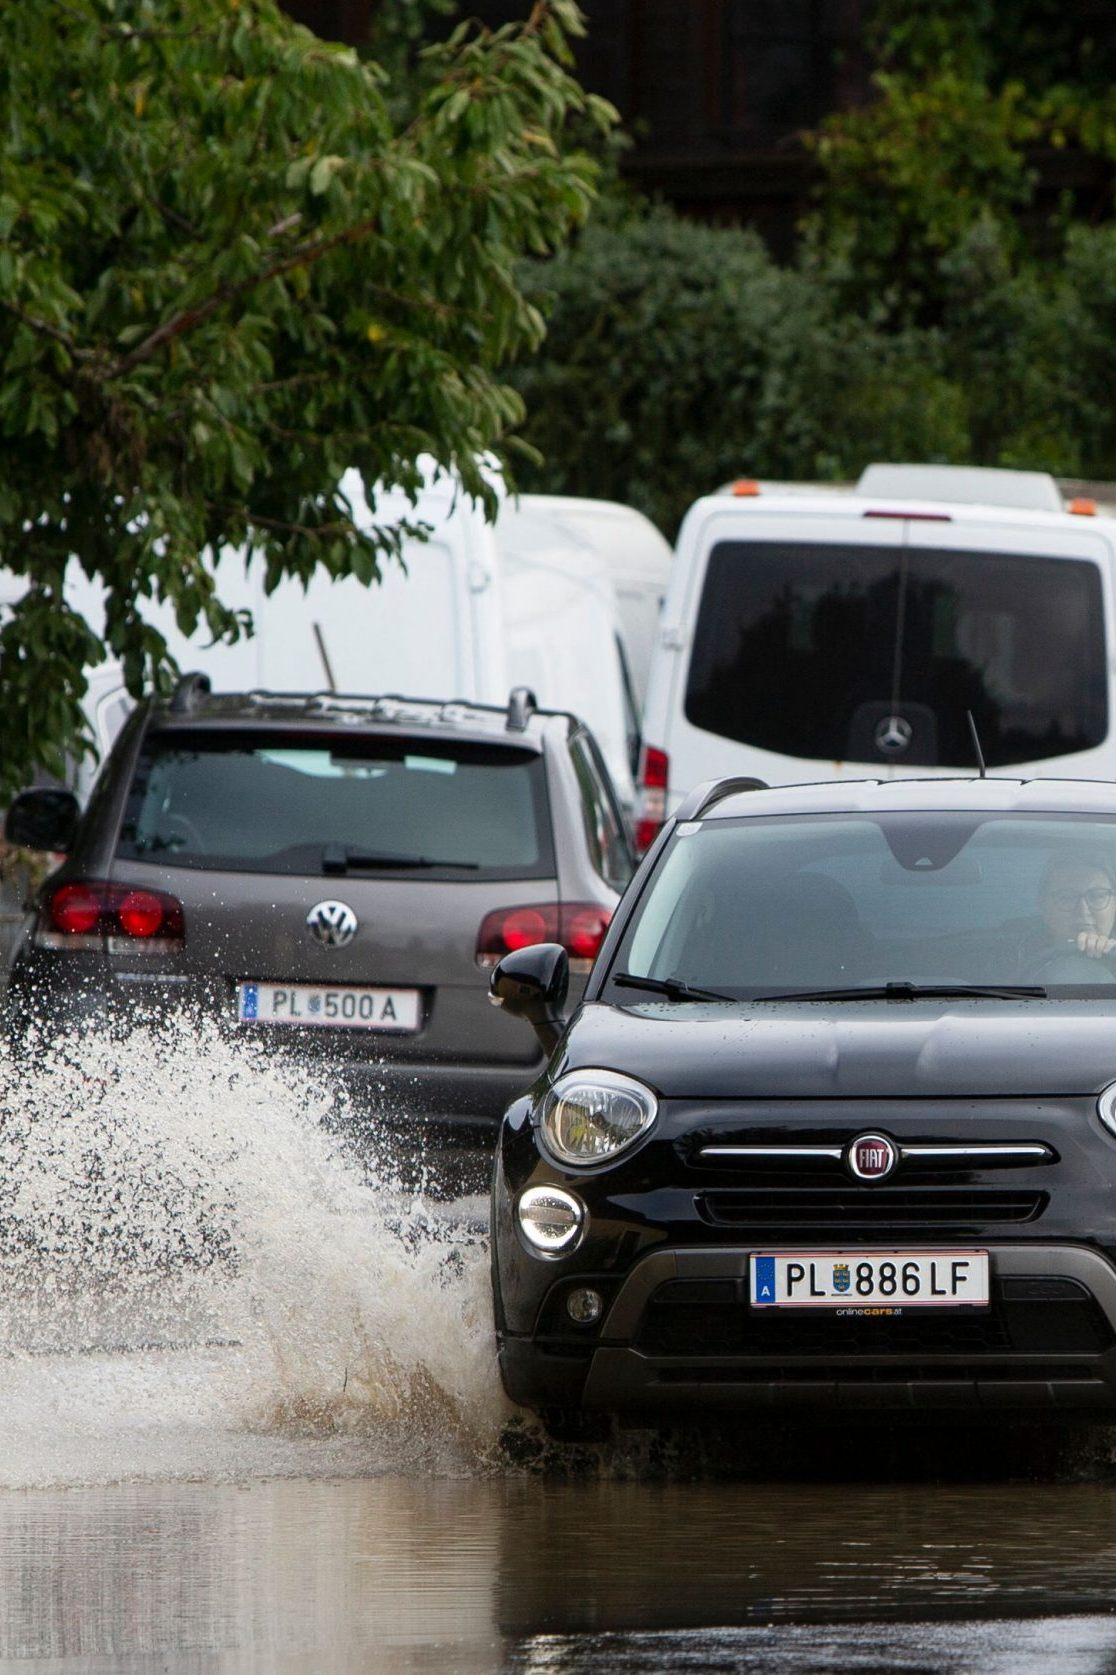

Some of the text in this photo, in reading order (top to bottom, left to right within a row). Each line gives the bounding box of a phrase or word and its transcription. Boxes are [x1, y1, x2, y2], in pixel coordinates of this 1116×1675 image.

[272, 990, 300, 1016] PL
[324, 993, 374, 1020] 500
[860, 1149, 884, 1168] FIAT
[761, 1285, 771, 1297] A
[786, 1263, 825, 1297] PL
